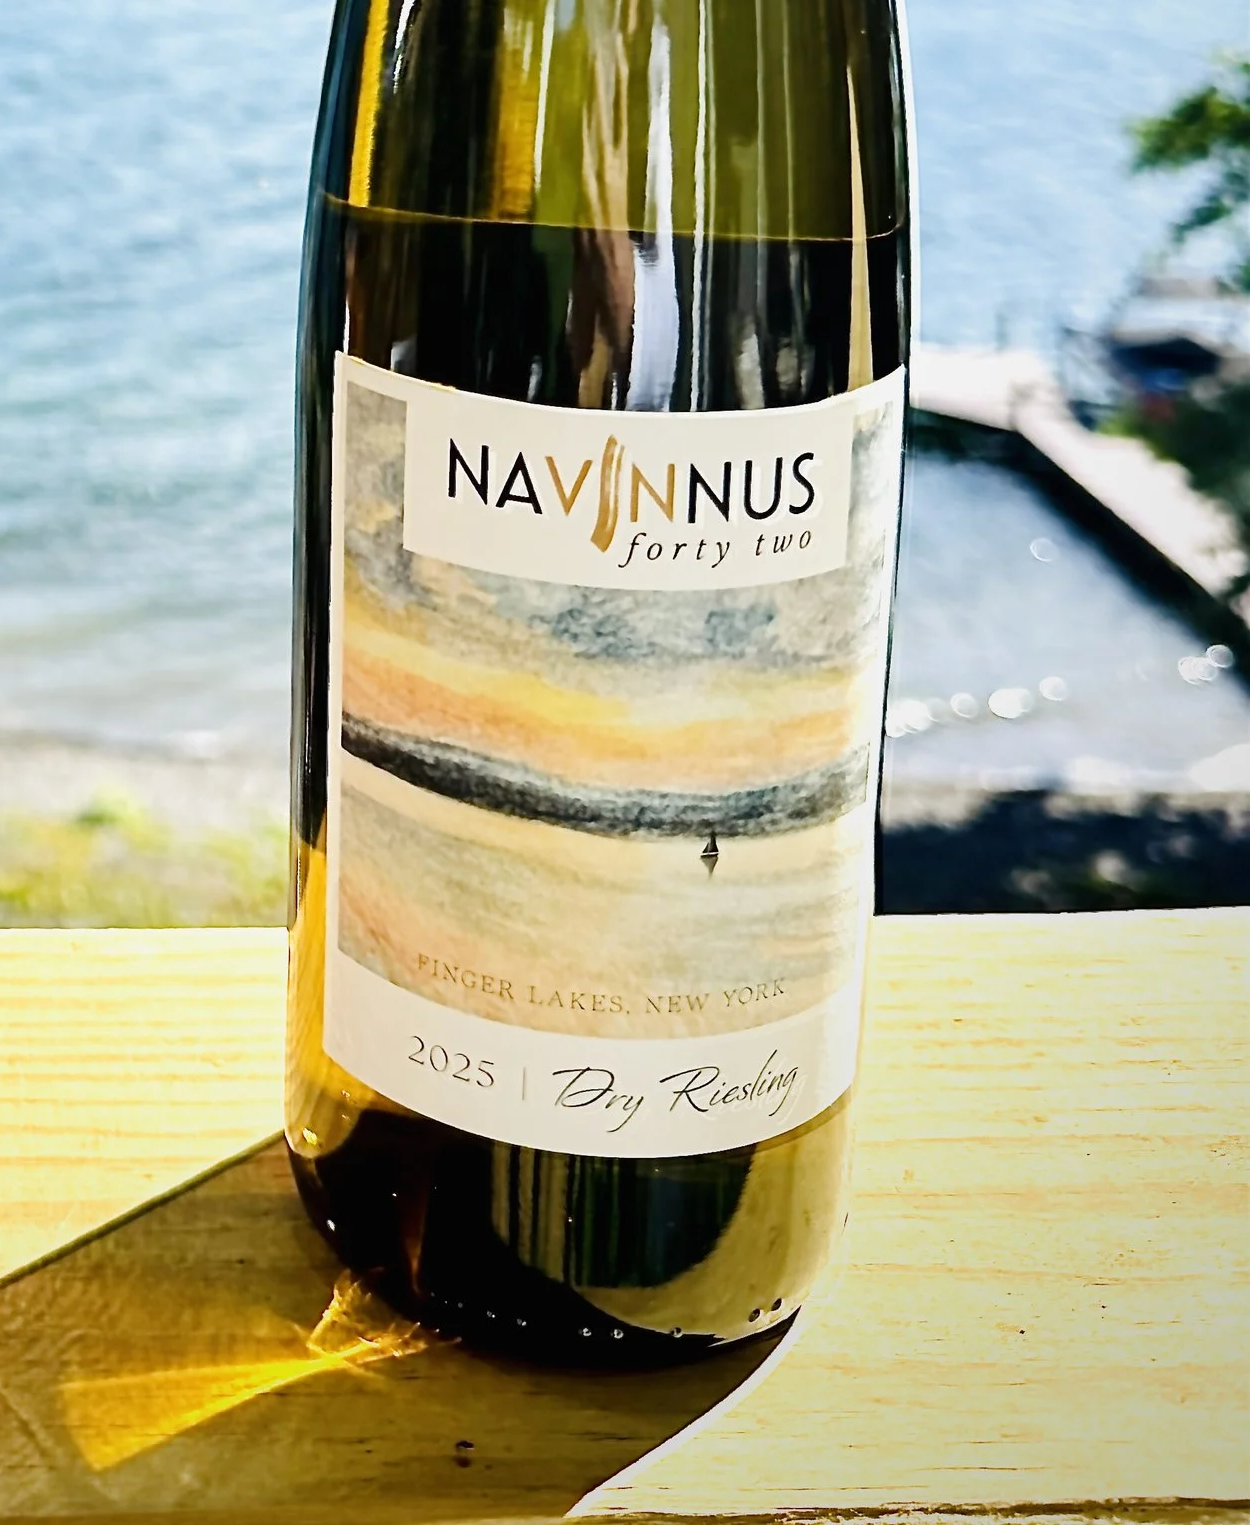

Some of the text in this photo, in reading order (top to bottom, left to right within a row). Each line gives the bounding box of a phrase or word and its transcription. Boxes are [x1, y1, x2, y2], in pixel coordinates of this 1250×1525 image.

[448, 434, 816, 553] NAVINNUS
[619, 528, 812, 568] forty two
[417, 951, 786, 1015] FINGER LAKES, NEW YORK
[407, 1034, 799, 1133] 2025 Dry Riesling
